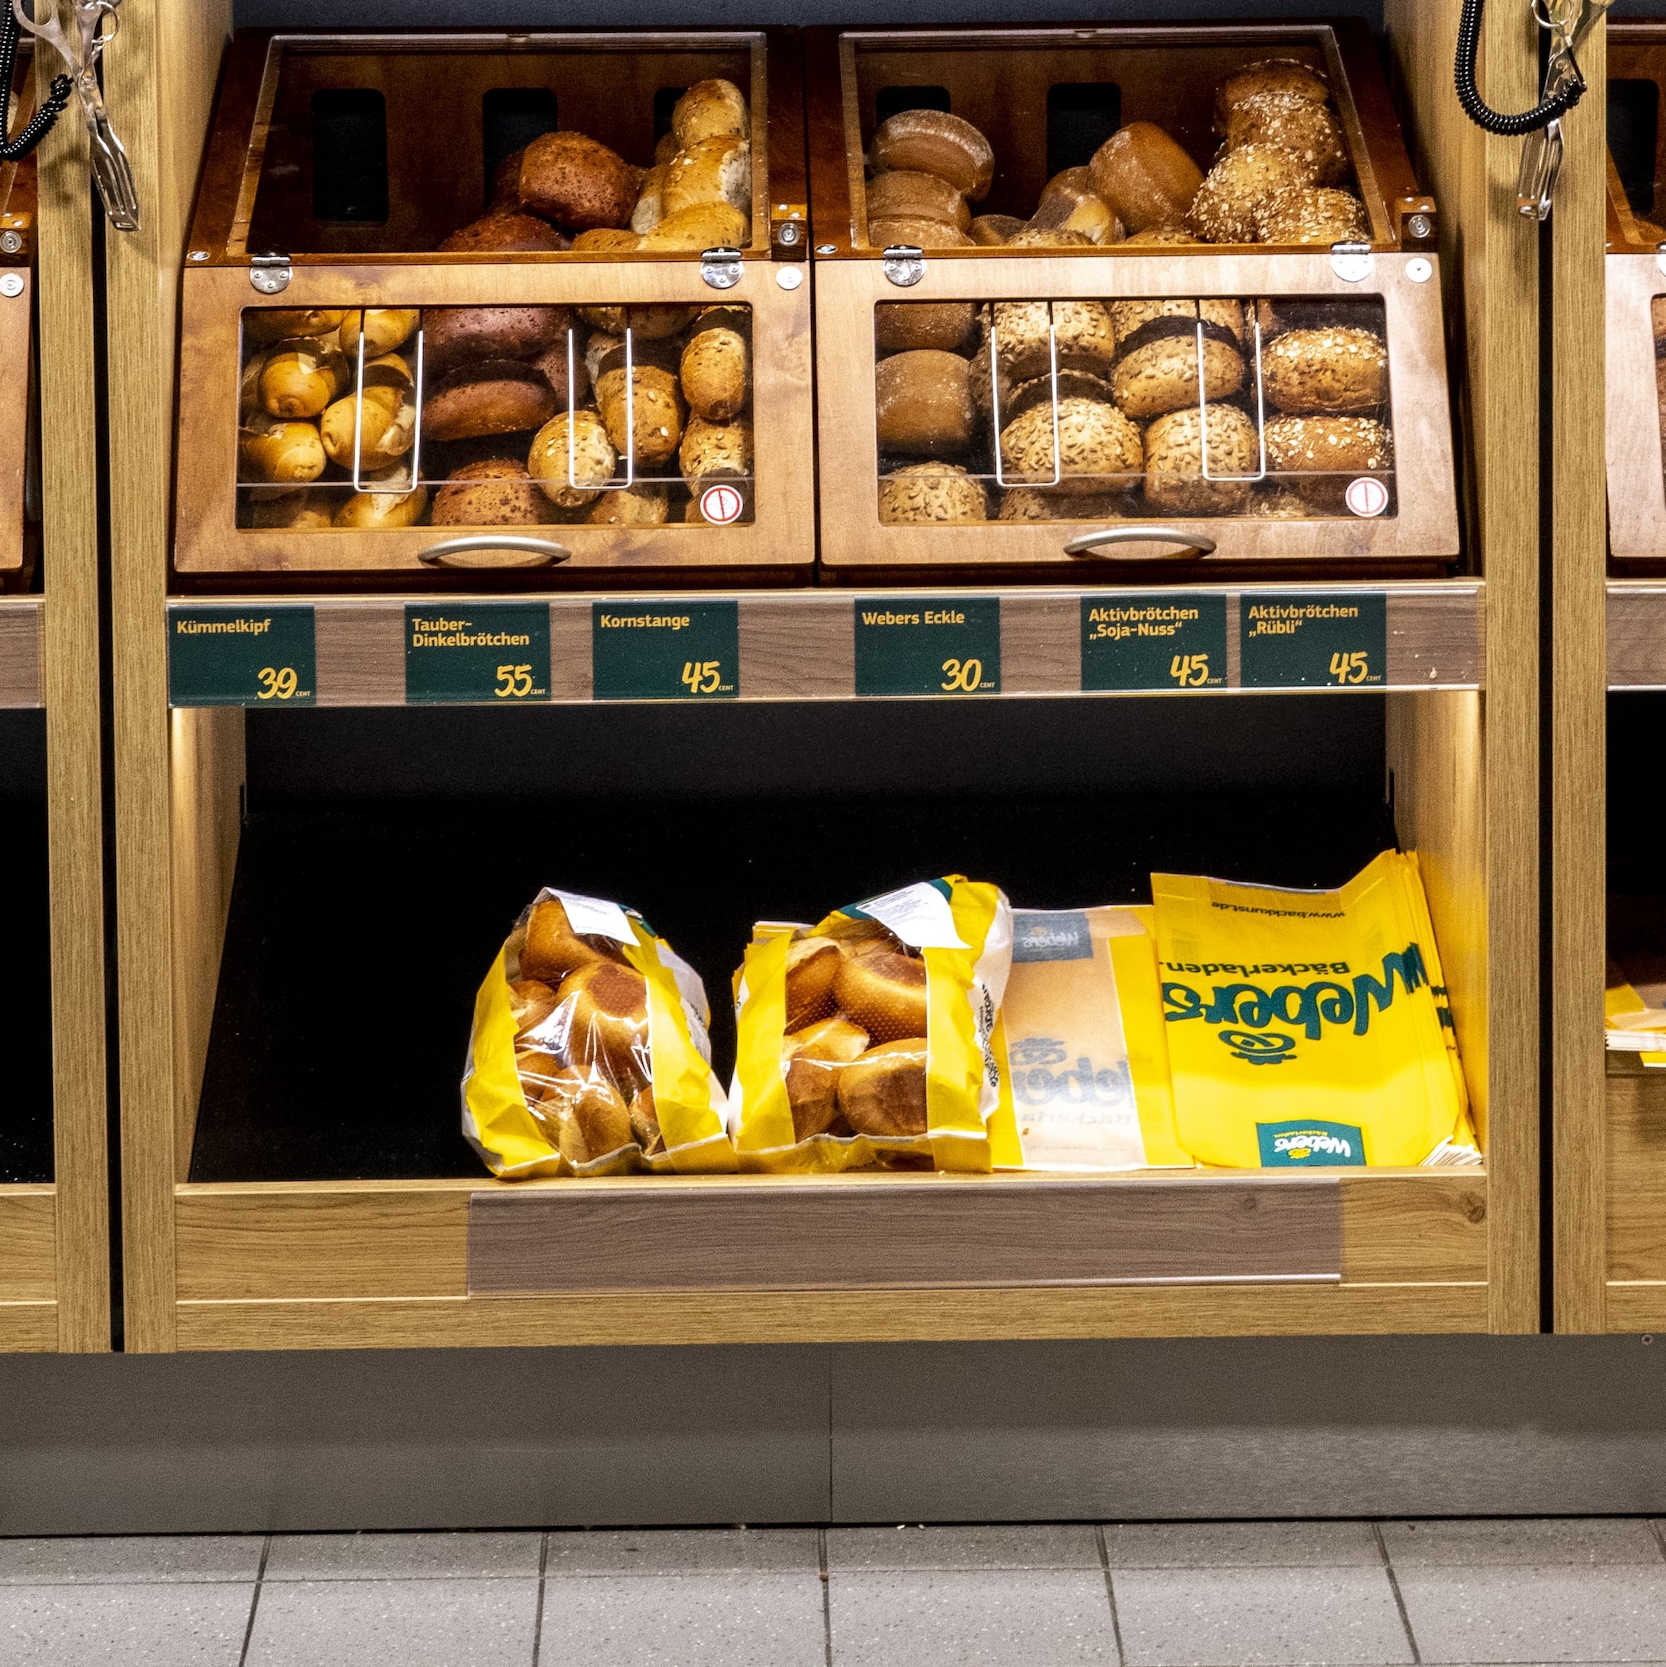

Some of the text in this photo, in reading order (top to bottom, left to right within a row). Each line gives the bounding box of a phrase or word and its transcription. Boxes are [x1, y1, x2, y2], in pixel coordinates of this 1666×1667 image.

[862, 610, 964, 625] Webers Eckle
[1089, 606, 1198, 622] Aktivbrötchen
[1249, 604, 1358, 619] Aktivbrötchen
[177, 619, 271, 635] Kümmelkipf
[412, 618, 472, 631] Tauber-
[601, 615, 690, 630] Kornstange
[413, 632, 529, 647] Dinkelbrötchen
[942, 659, 982, 691] 30
[1170, 654, 1210, 686] 45
[1329, 651, 1368, 684] 45
[257, 668, 298, 699] 39
[495, 664, 533, 697] 55
[682, 661, 721, 693] 45
[1211, 901, 1346, 919] www.backkunst.de
[1274, 1135, 1351, 1158] Webers
